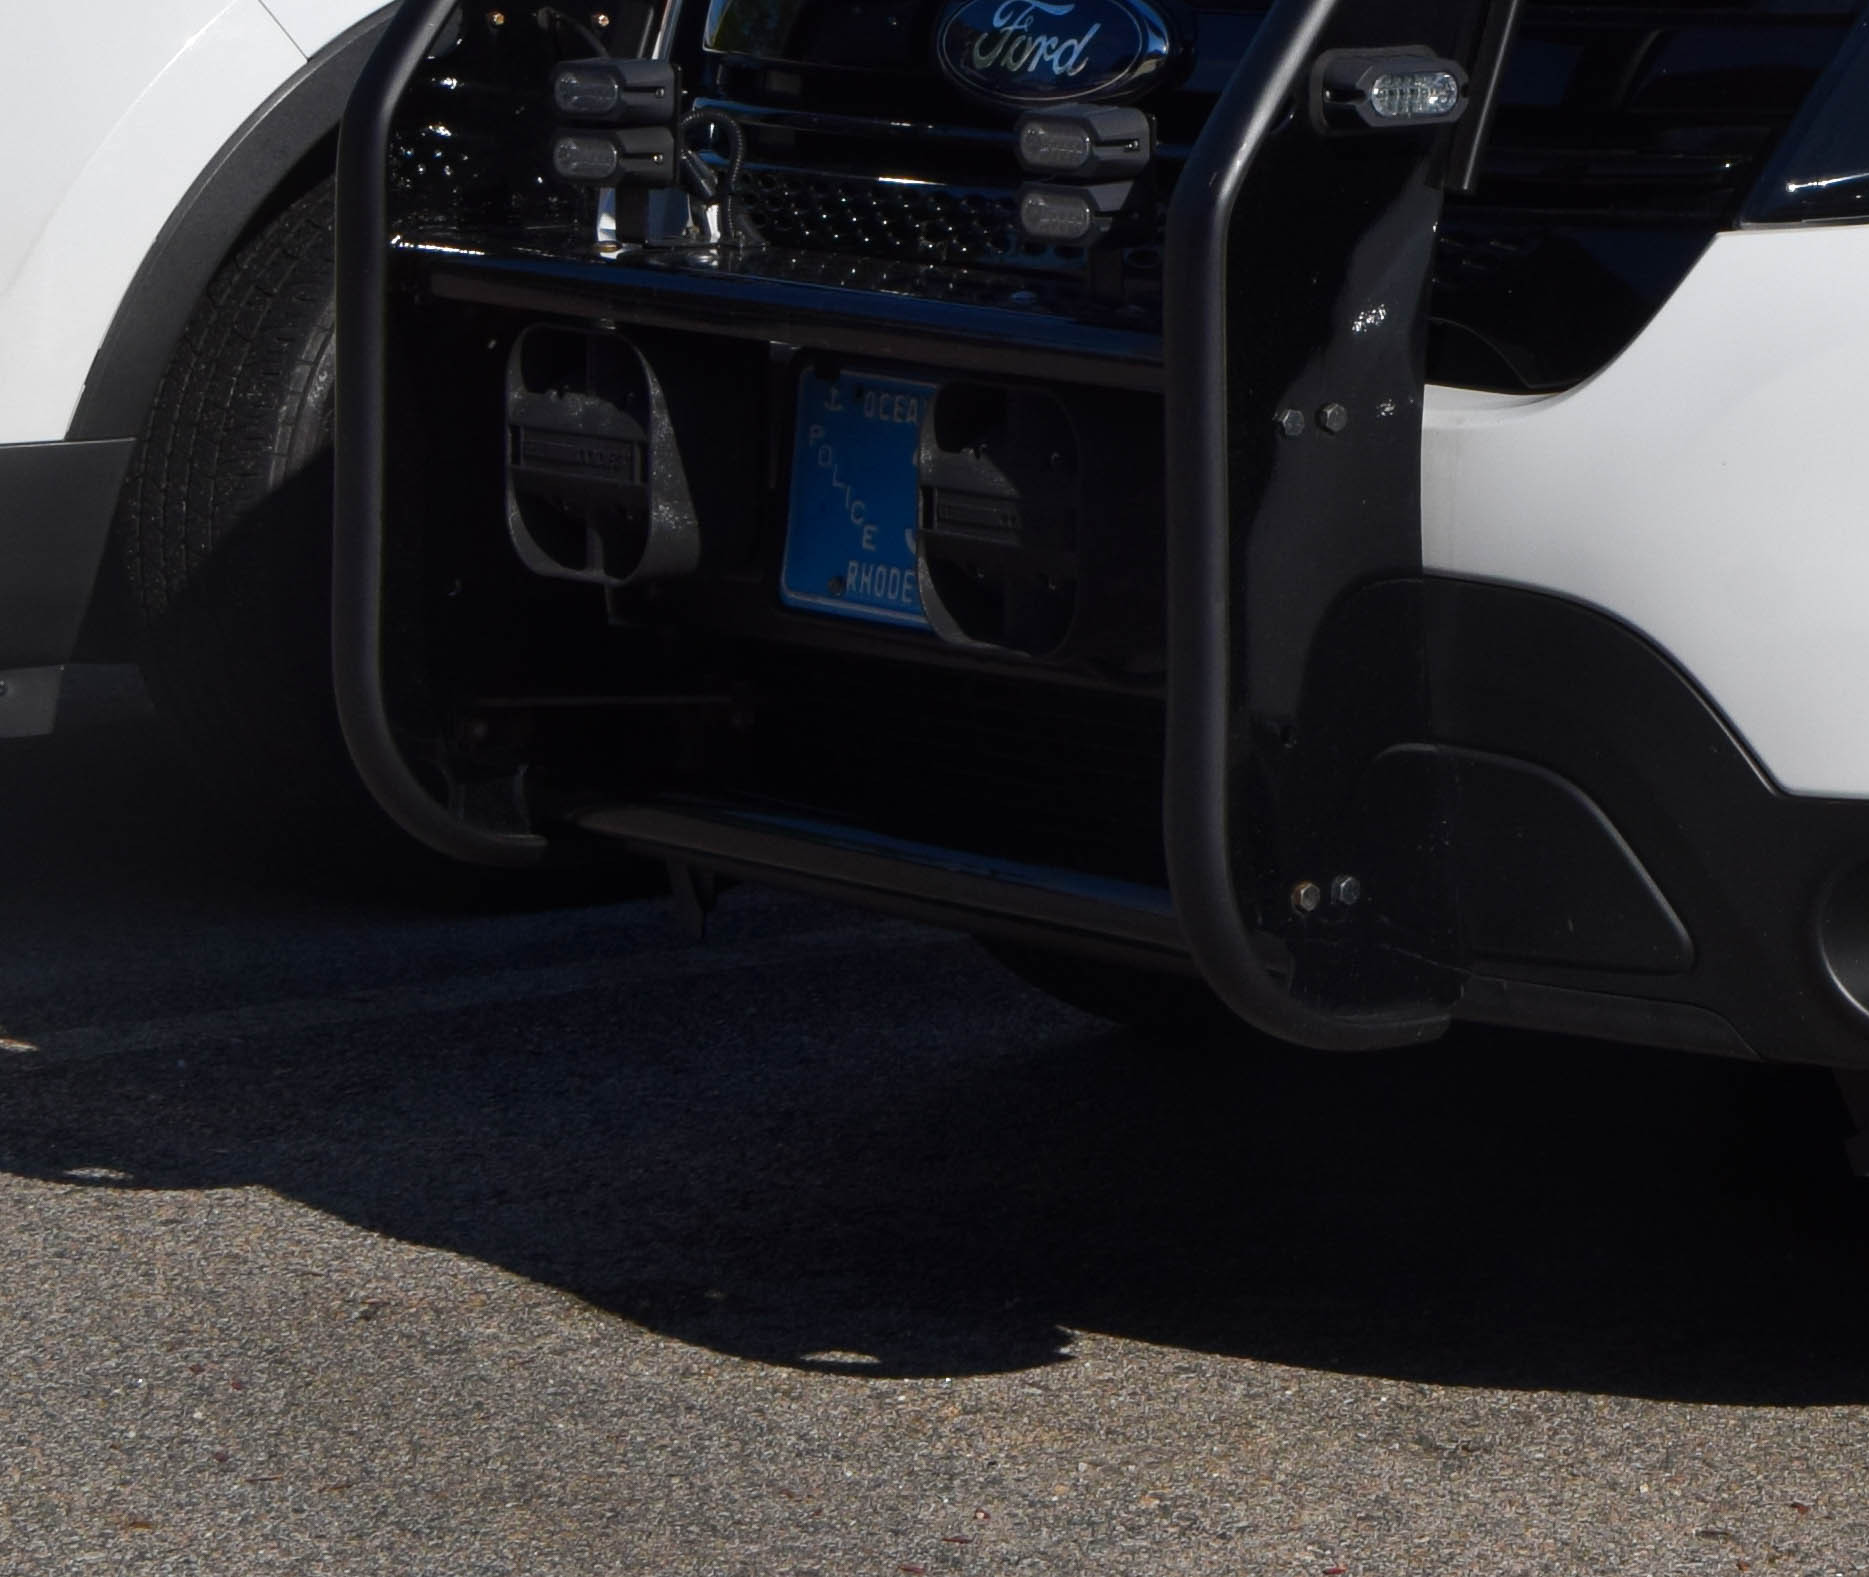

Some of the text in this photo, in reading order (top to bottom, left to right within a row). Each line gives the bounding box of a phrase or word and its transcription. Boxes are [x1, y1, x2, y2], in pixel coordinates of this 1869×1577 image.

[864, 391, 928, 424] OCEA
[809, 424, 878, 552] POLICE
[846, 560, 917, 605] RHODE
